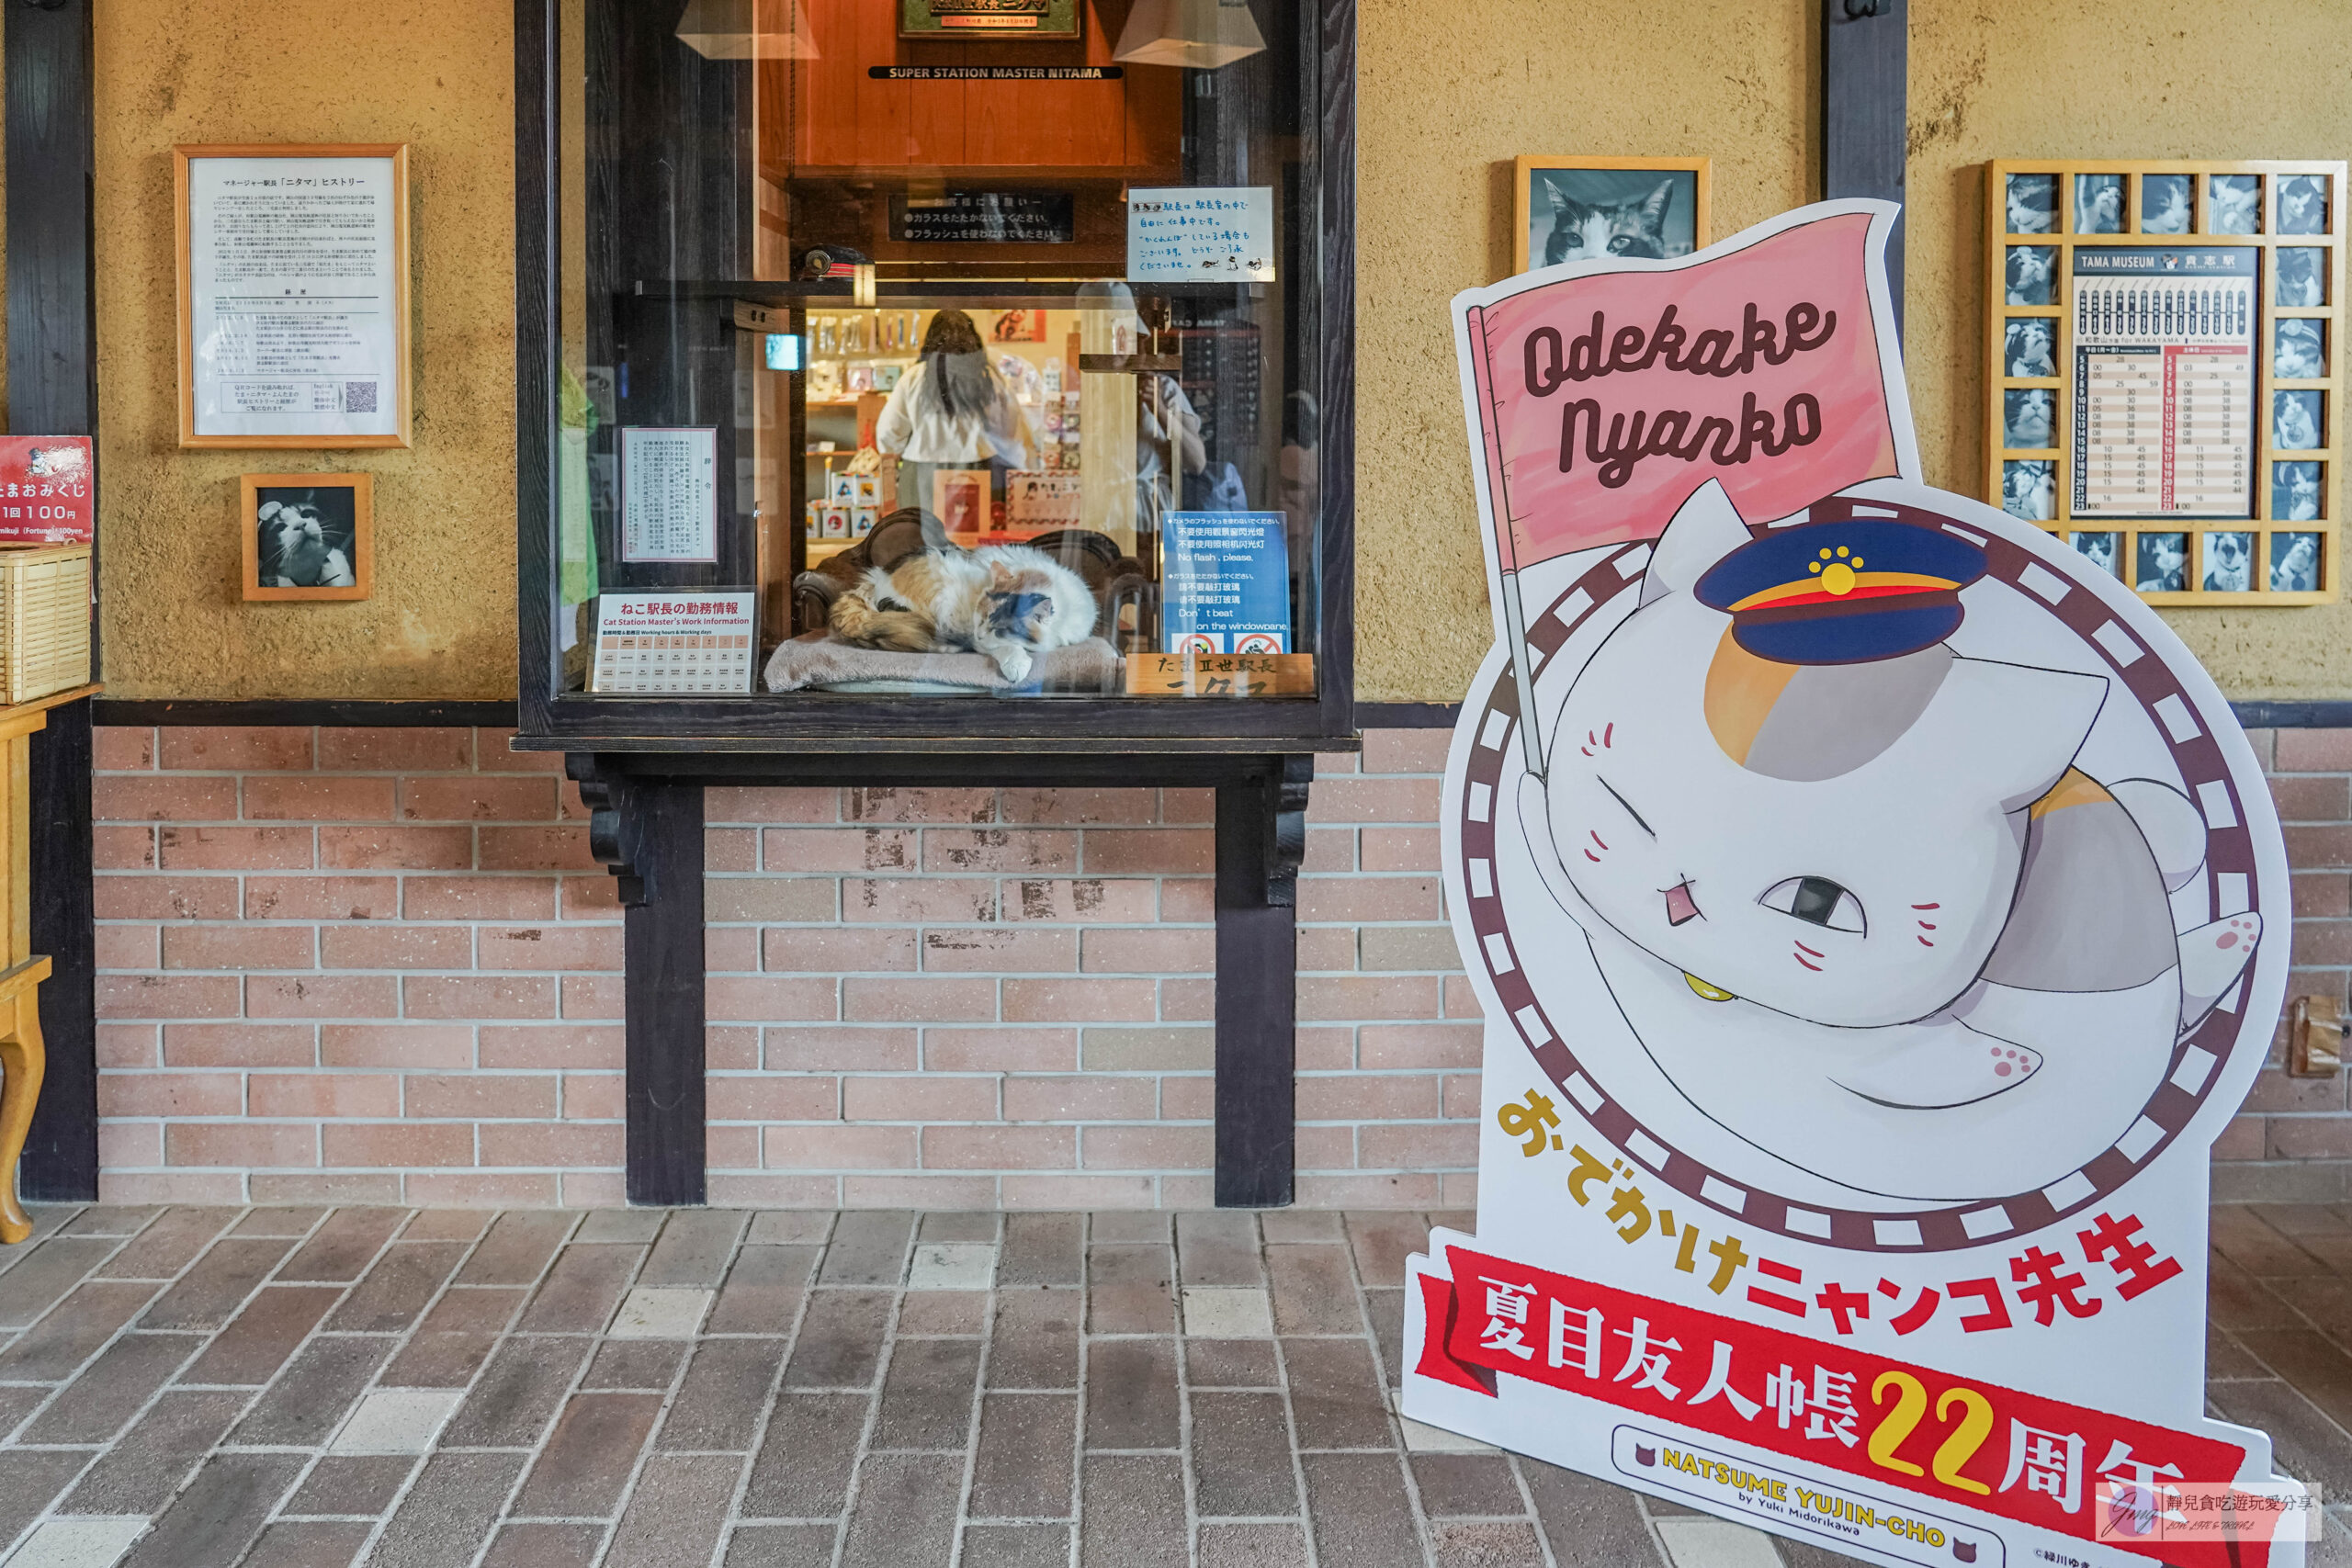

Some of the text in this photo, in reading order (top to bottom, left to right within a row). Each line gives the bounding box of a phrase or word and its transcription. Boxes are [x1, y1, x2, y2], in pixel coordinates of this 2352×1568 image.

[889, 68, 1102, 79] SUPER STATION MASTER NITAMA
[2082, 256, 2154, 267] TAMA MUSEUM
[1523, 302, 1837, 398] Odekake
[2077, 396, 2086, 404] 10
[2077, 404, 2086, 412] 11
[2077, 412, 2086, 421] 12
[1178, 540, 1264, 548] 不要使用照相机闪光灯
[1178, 553, 1192, 561] No
[1194, 553, 1216, 561] flash
[1178, 582, 1240, 592] 請不要敲打玻璃
[1179, 595, 1240, 604] 请不要敲打玻璃
[620, 602, 739, 615] ねこ駅長の勤務情報
[1213, 608, 1234, 617] beat
[618, 617, 646, 626] Station
[648, 616, 681, 626] Master's
[682, 617, 702, 626] Work
[704, 616, 750, 625] Information
[1211, 622, 1227, 630] the
[1497, 1088, 2185, 1337] おでかけニャンコ先生
[1477, 1275, 2188, 1538] 夏目友人帳22周年
[1663, 1447, 1946, 1548] NATSUME YUJIN-CHO
[1737, 1491, 1860, 1537] by Yuki Midorikawa
